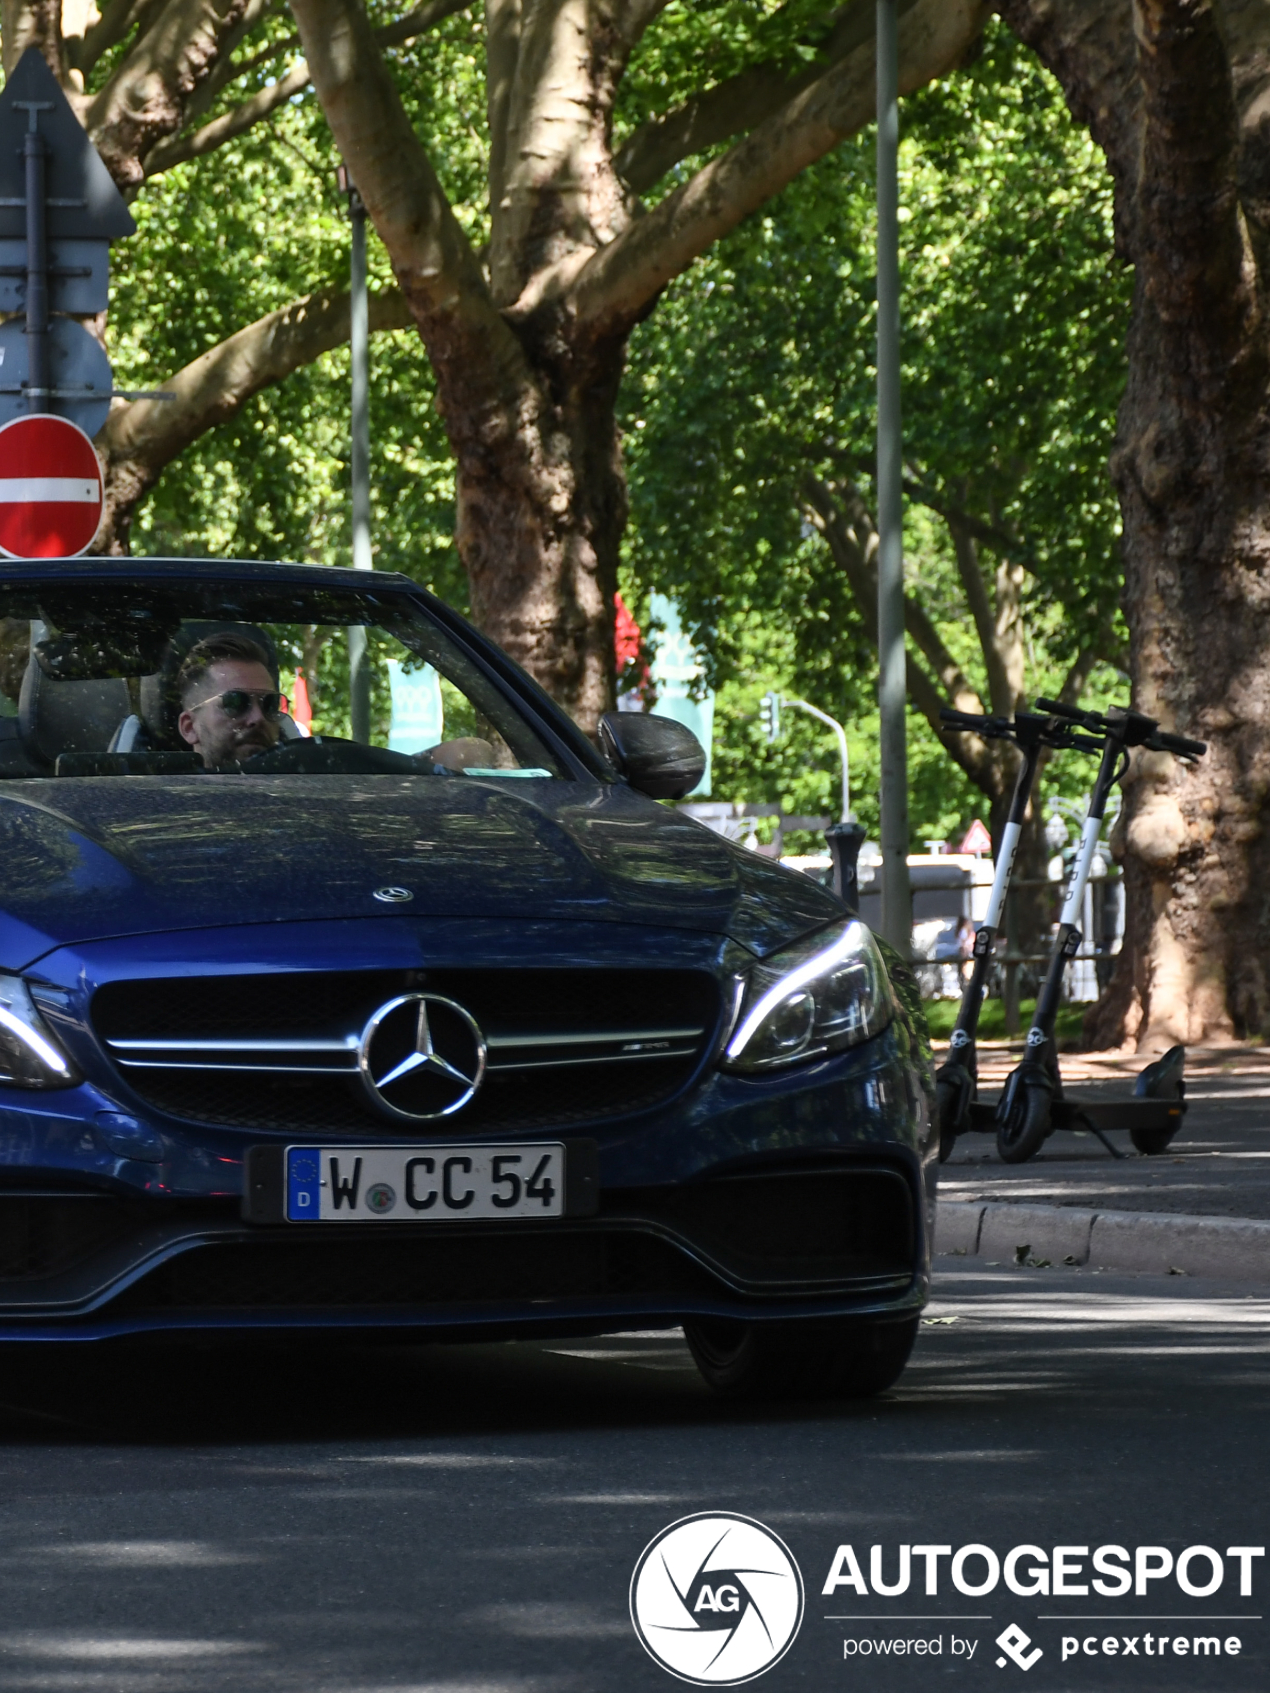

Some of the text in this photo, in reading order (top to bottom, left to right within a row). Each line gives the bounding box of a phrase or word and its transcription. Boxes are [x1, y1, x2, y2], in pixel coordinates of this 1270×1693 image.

[297, 1192, 310, 1207] D
[329, 1153, 556, 1211] W CC 54
